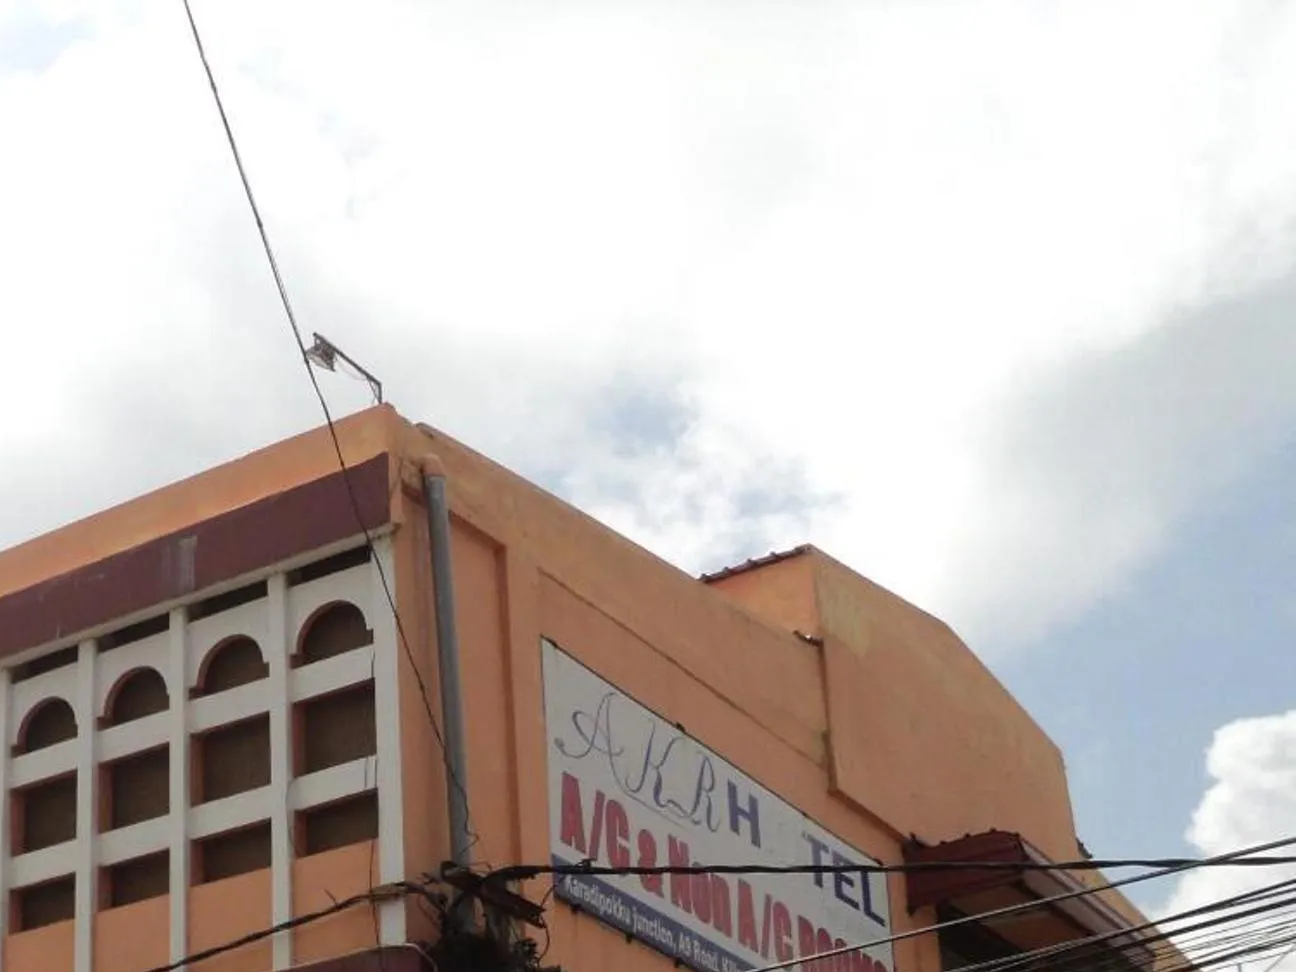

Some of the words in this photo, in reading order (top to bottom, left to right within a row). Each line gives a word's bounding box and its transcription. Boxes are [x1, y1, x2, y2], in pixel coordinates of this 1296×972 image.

[560, 771, 630, 876] A/C
[638, 828, 664, 898] &
[668, 834, 732, 938] Non
[738, 878, 794, 972] A/C
